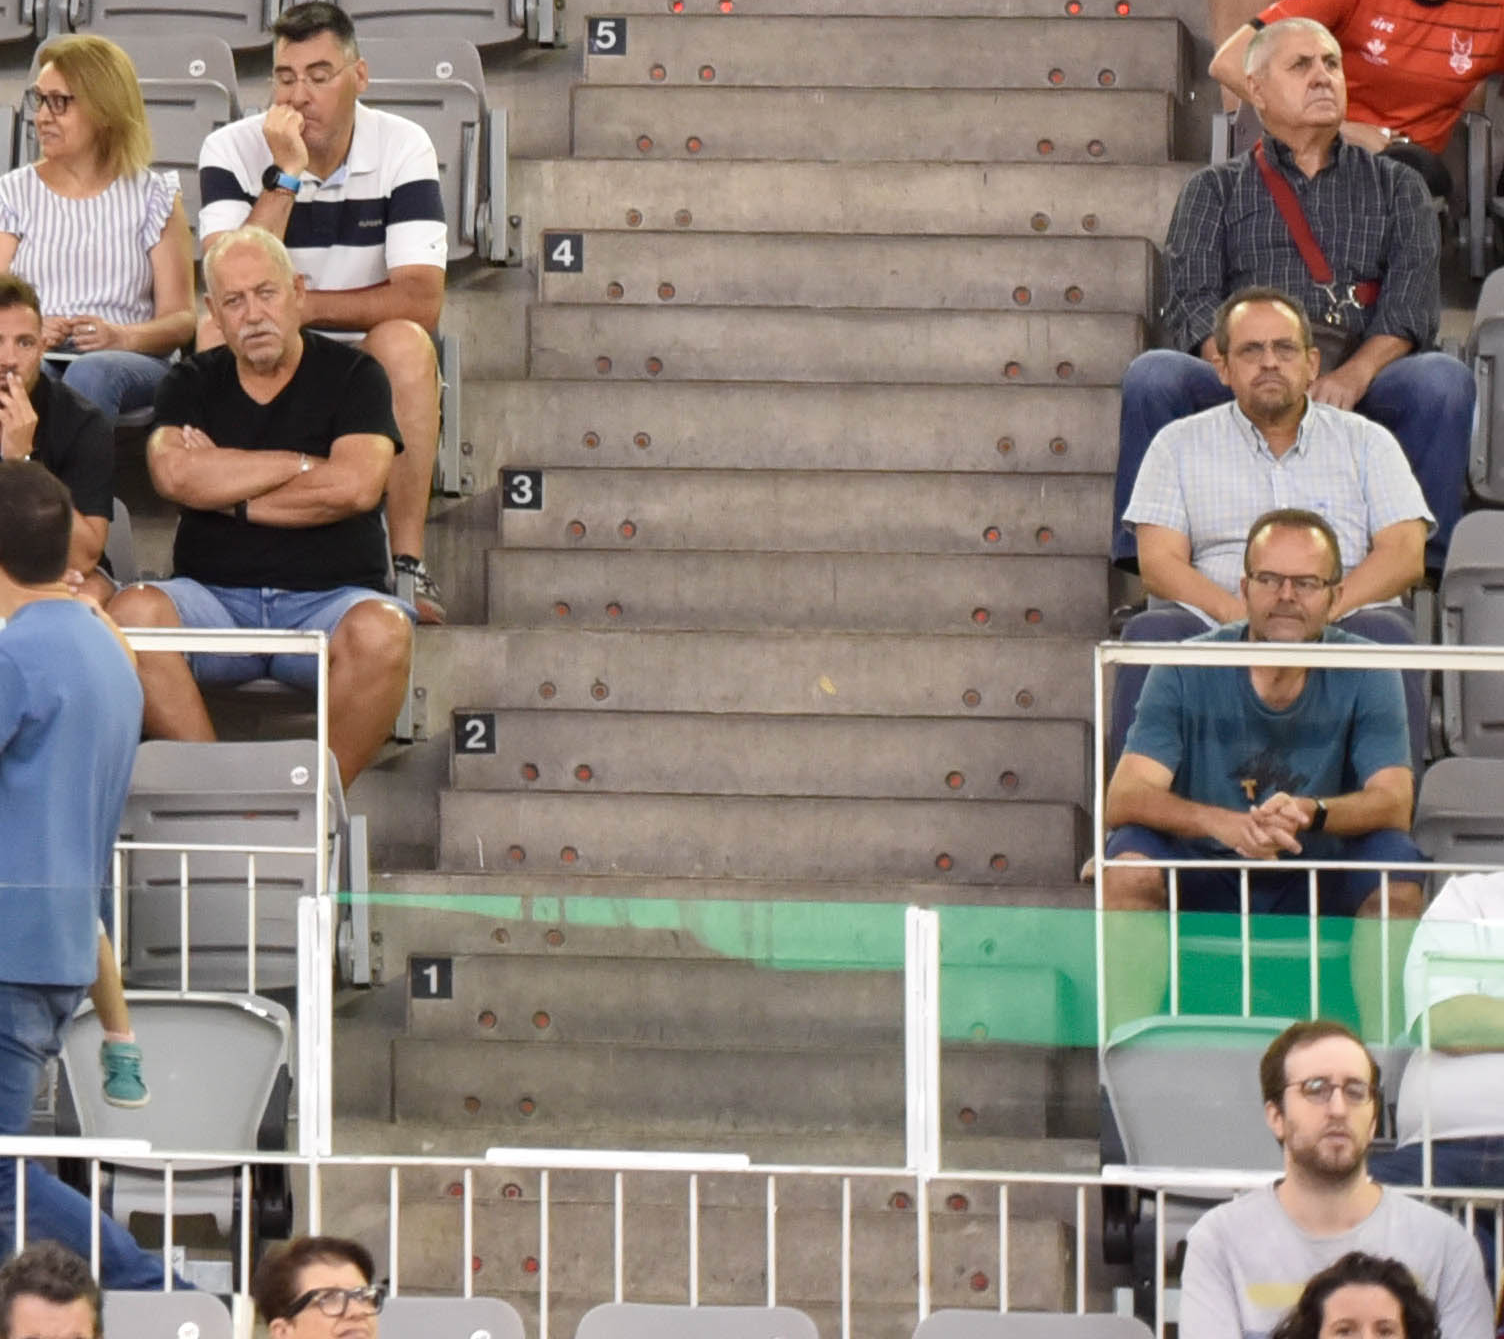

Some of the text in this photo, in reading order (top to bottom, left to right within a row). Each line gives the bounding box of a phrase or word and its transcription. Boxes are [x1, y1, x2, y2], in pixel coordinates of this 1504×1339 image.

[595, 20, 617, 50] 5
[552, 238, 575, 267] 4
[510, 474, 534, 505] 3
[464, 718, 487, 749] 2
[423, 964, 439, 995] 1
